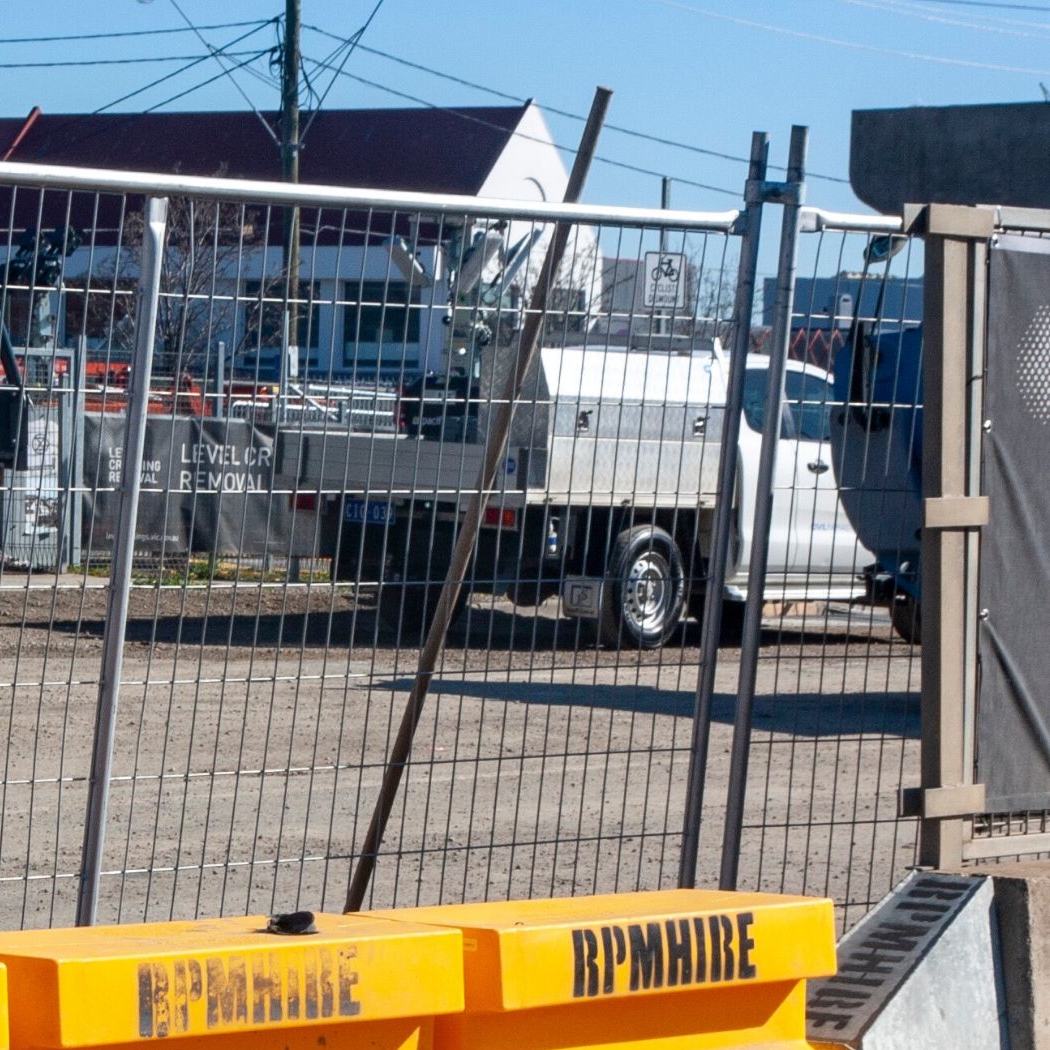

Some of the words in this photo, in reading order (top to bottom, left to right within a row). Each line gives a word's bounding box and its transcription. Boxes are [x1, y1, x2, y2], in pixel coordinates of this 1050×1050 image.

[181, 443, 241, 466] LEVEL
[109, 459, 161, 472] CRING
[109, 471, 158, 484] REVAL
[180, 471, 263, 491] REMOVAL
[571, 912, 756, 998] RPMHIRE
[138, 945, 361, 1038] RPMHIRE
